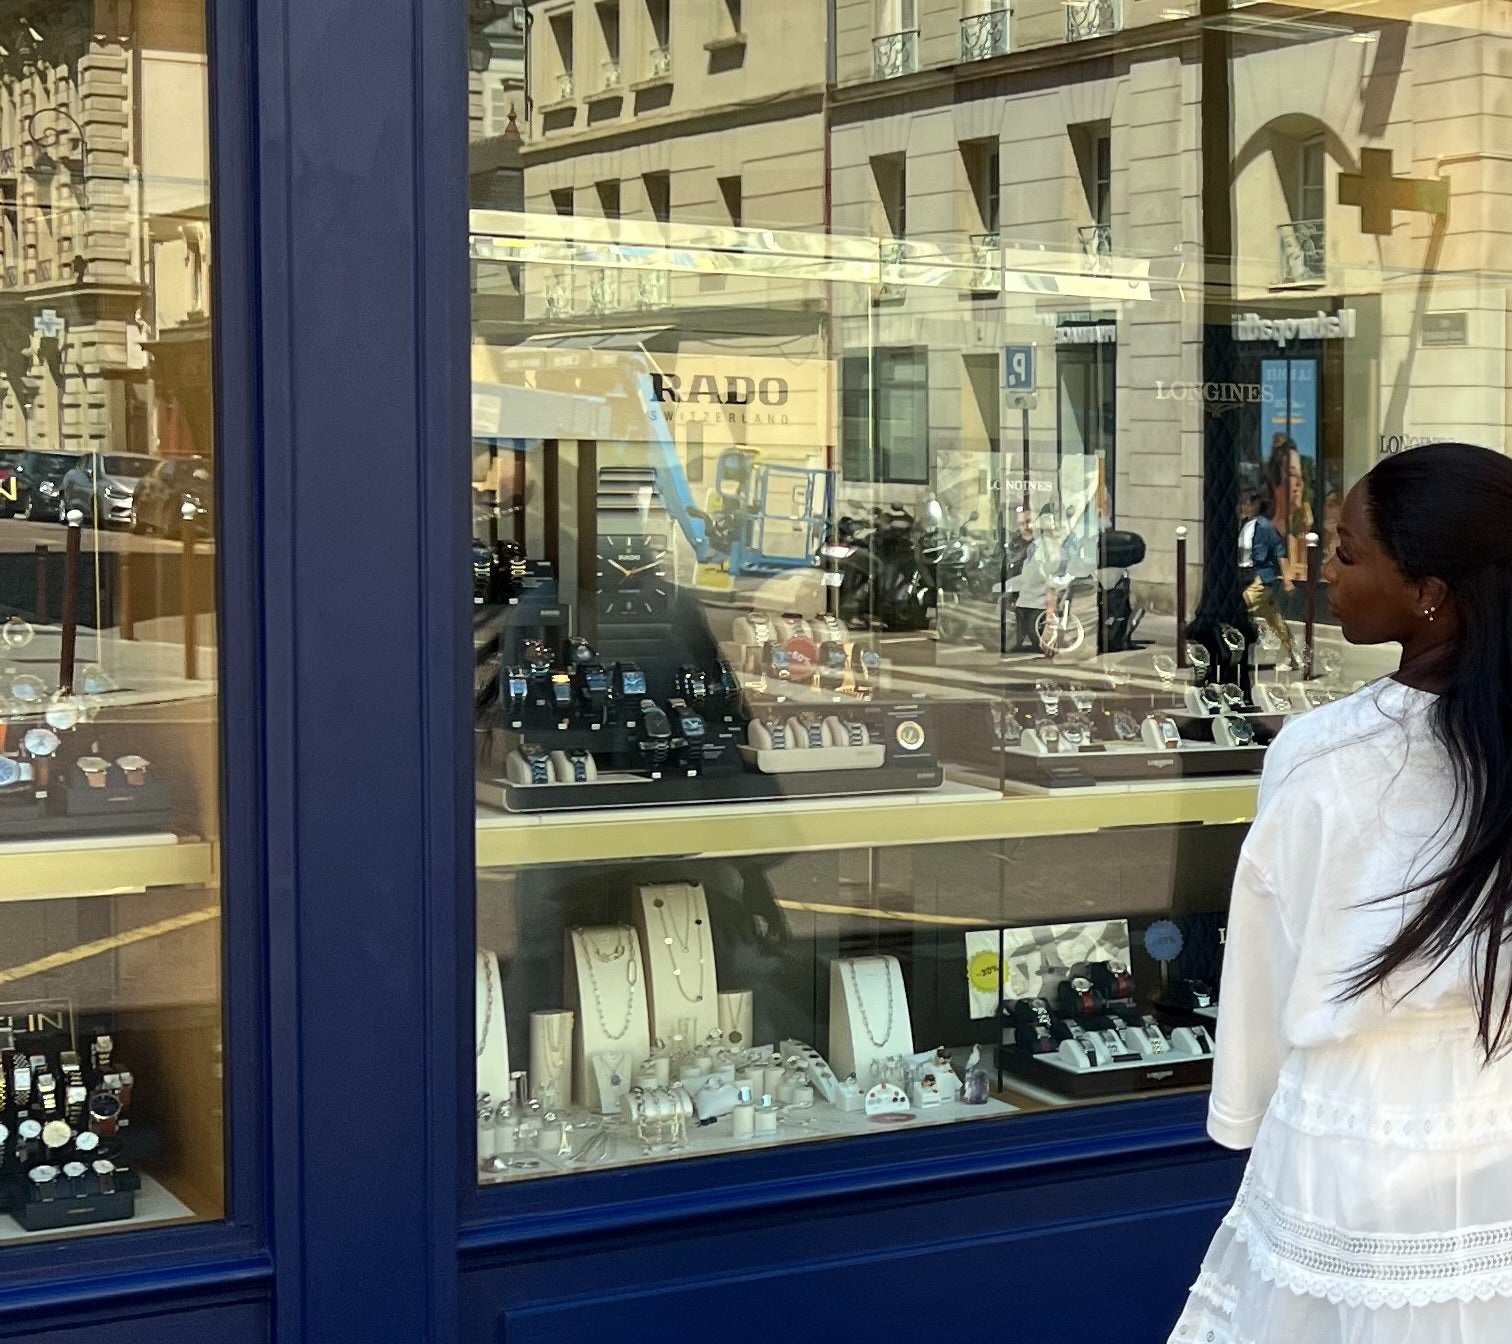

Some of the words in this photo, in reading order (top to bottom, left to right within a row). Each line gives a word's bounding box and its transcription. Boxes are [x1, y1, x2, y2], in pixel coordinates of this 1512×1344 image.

[650, 373, 788, 406] RADO
[1155, 381, 1274, 402] LONGINES
[650, 410, 789, 425] SWITZERLAND
